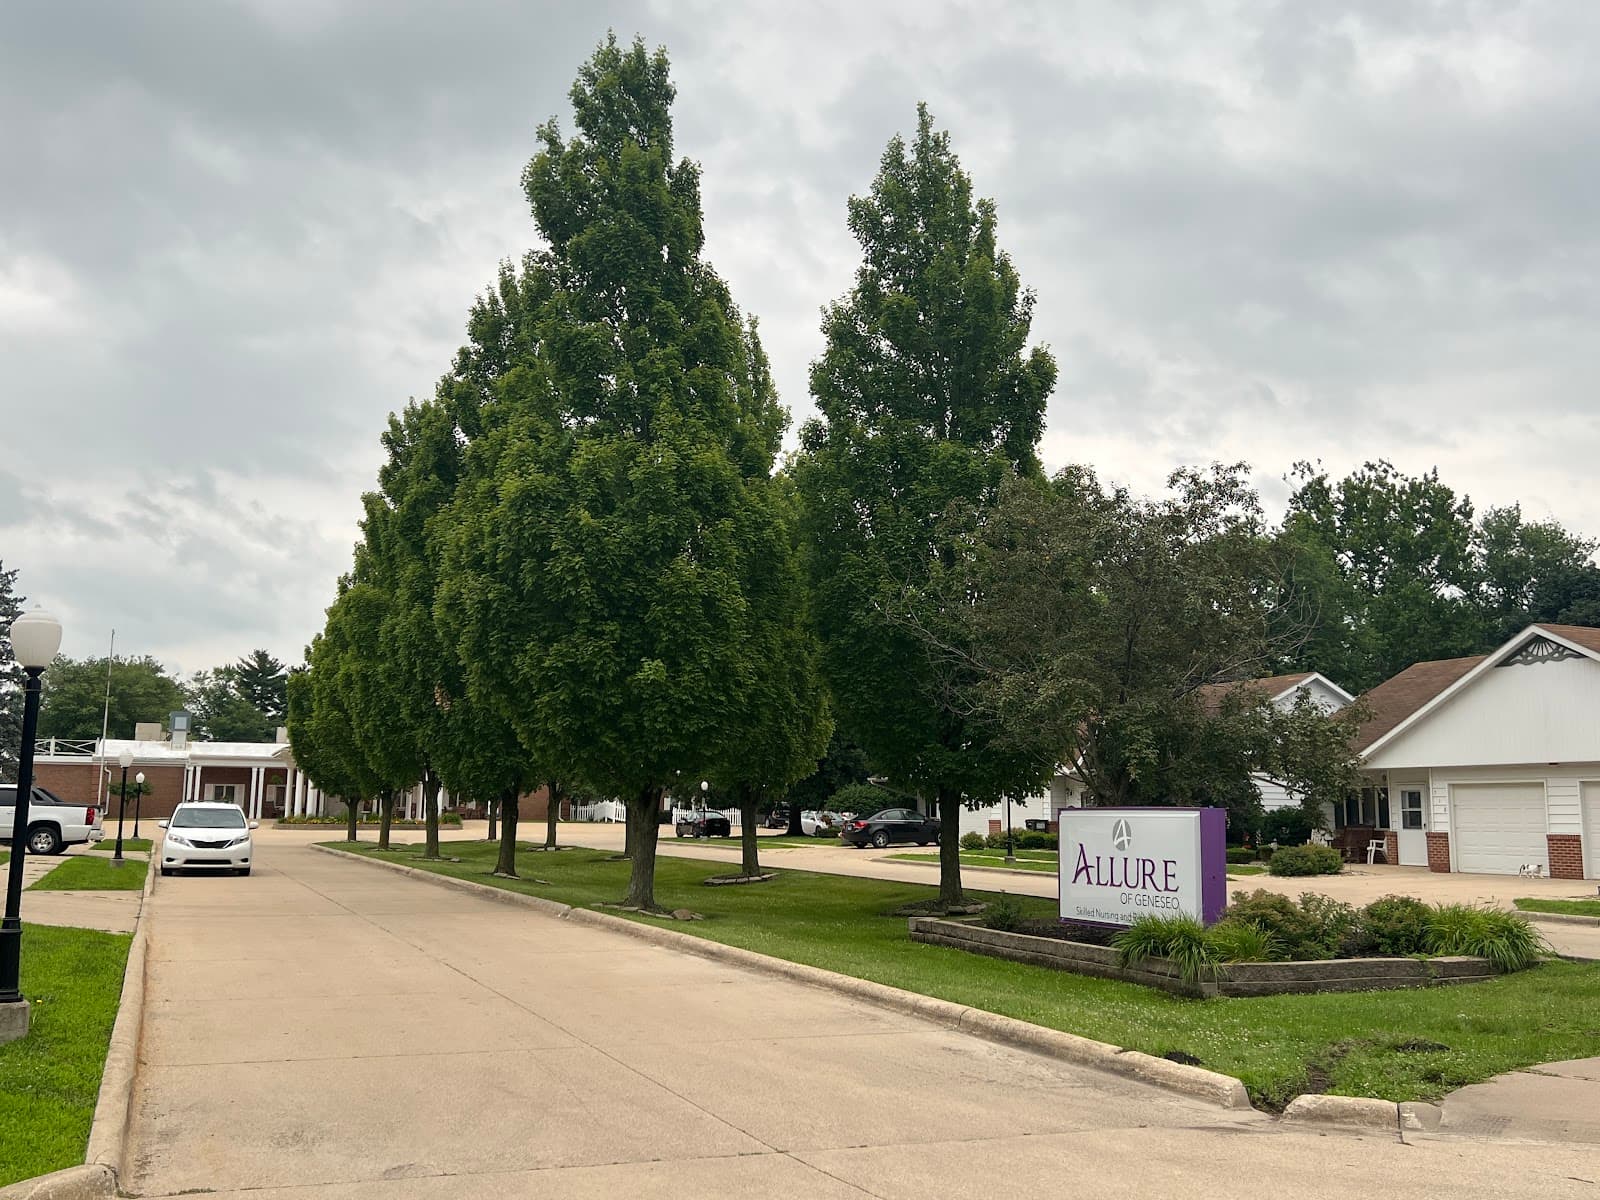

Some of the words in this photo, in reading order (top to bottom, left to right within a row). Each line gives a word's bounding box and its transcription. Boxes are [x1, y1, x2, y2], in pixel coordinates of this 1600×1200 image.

[1072, 843, 1179, 892] ALLURE
[1120, 892, 1133, 905] OF
[1135, 893, 1180, 910] GENESEO
[1075, 906, 1095, 917] Skilled
[1096, 908, 1119, 922] Nursing
[1120, 912, 1132, 922] and
